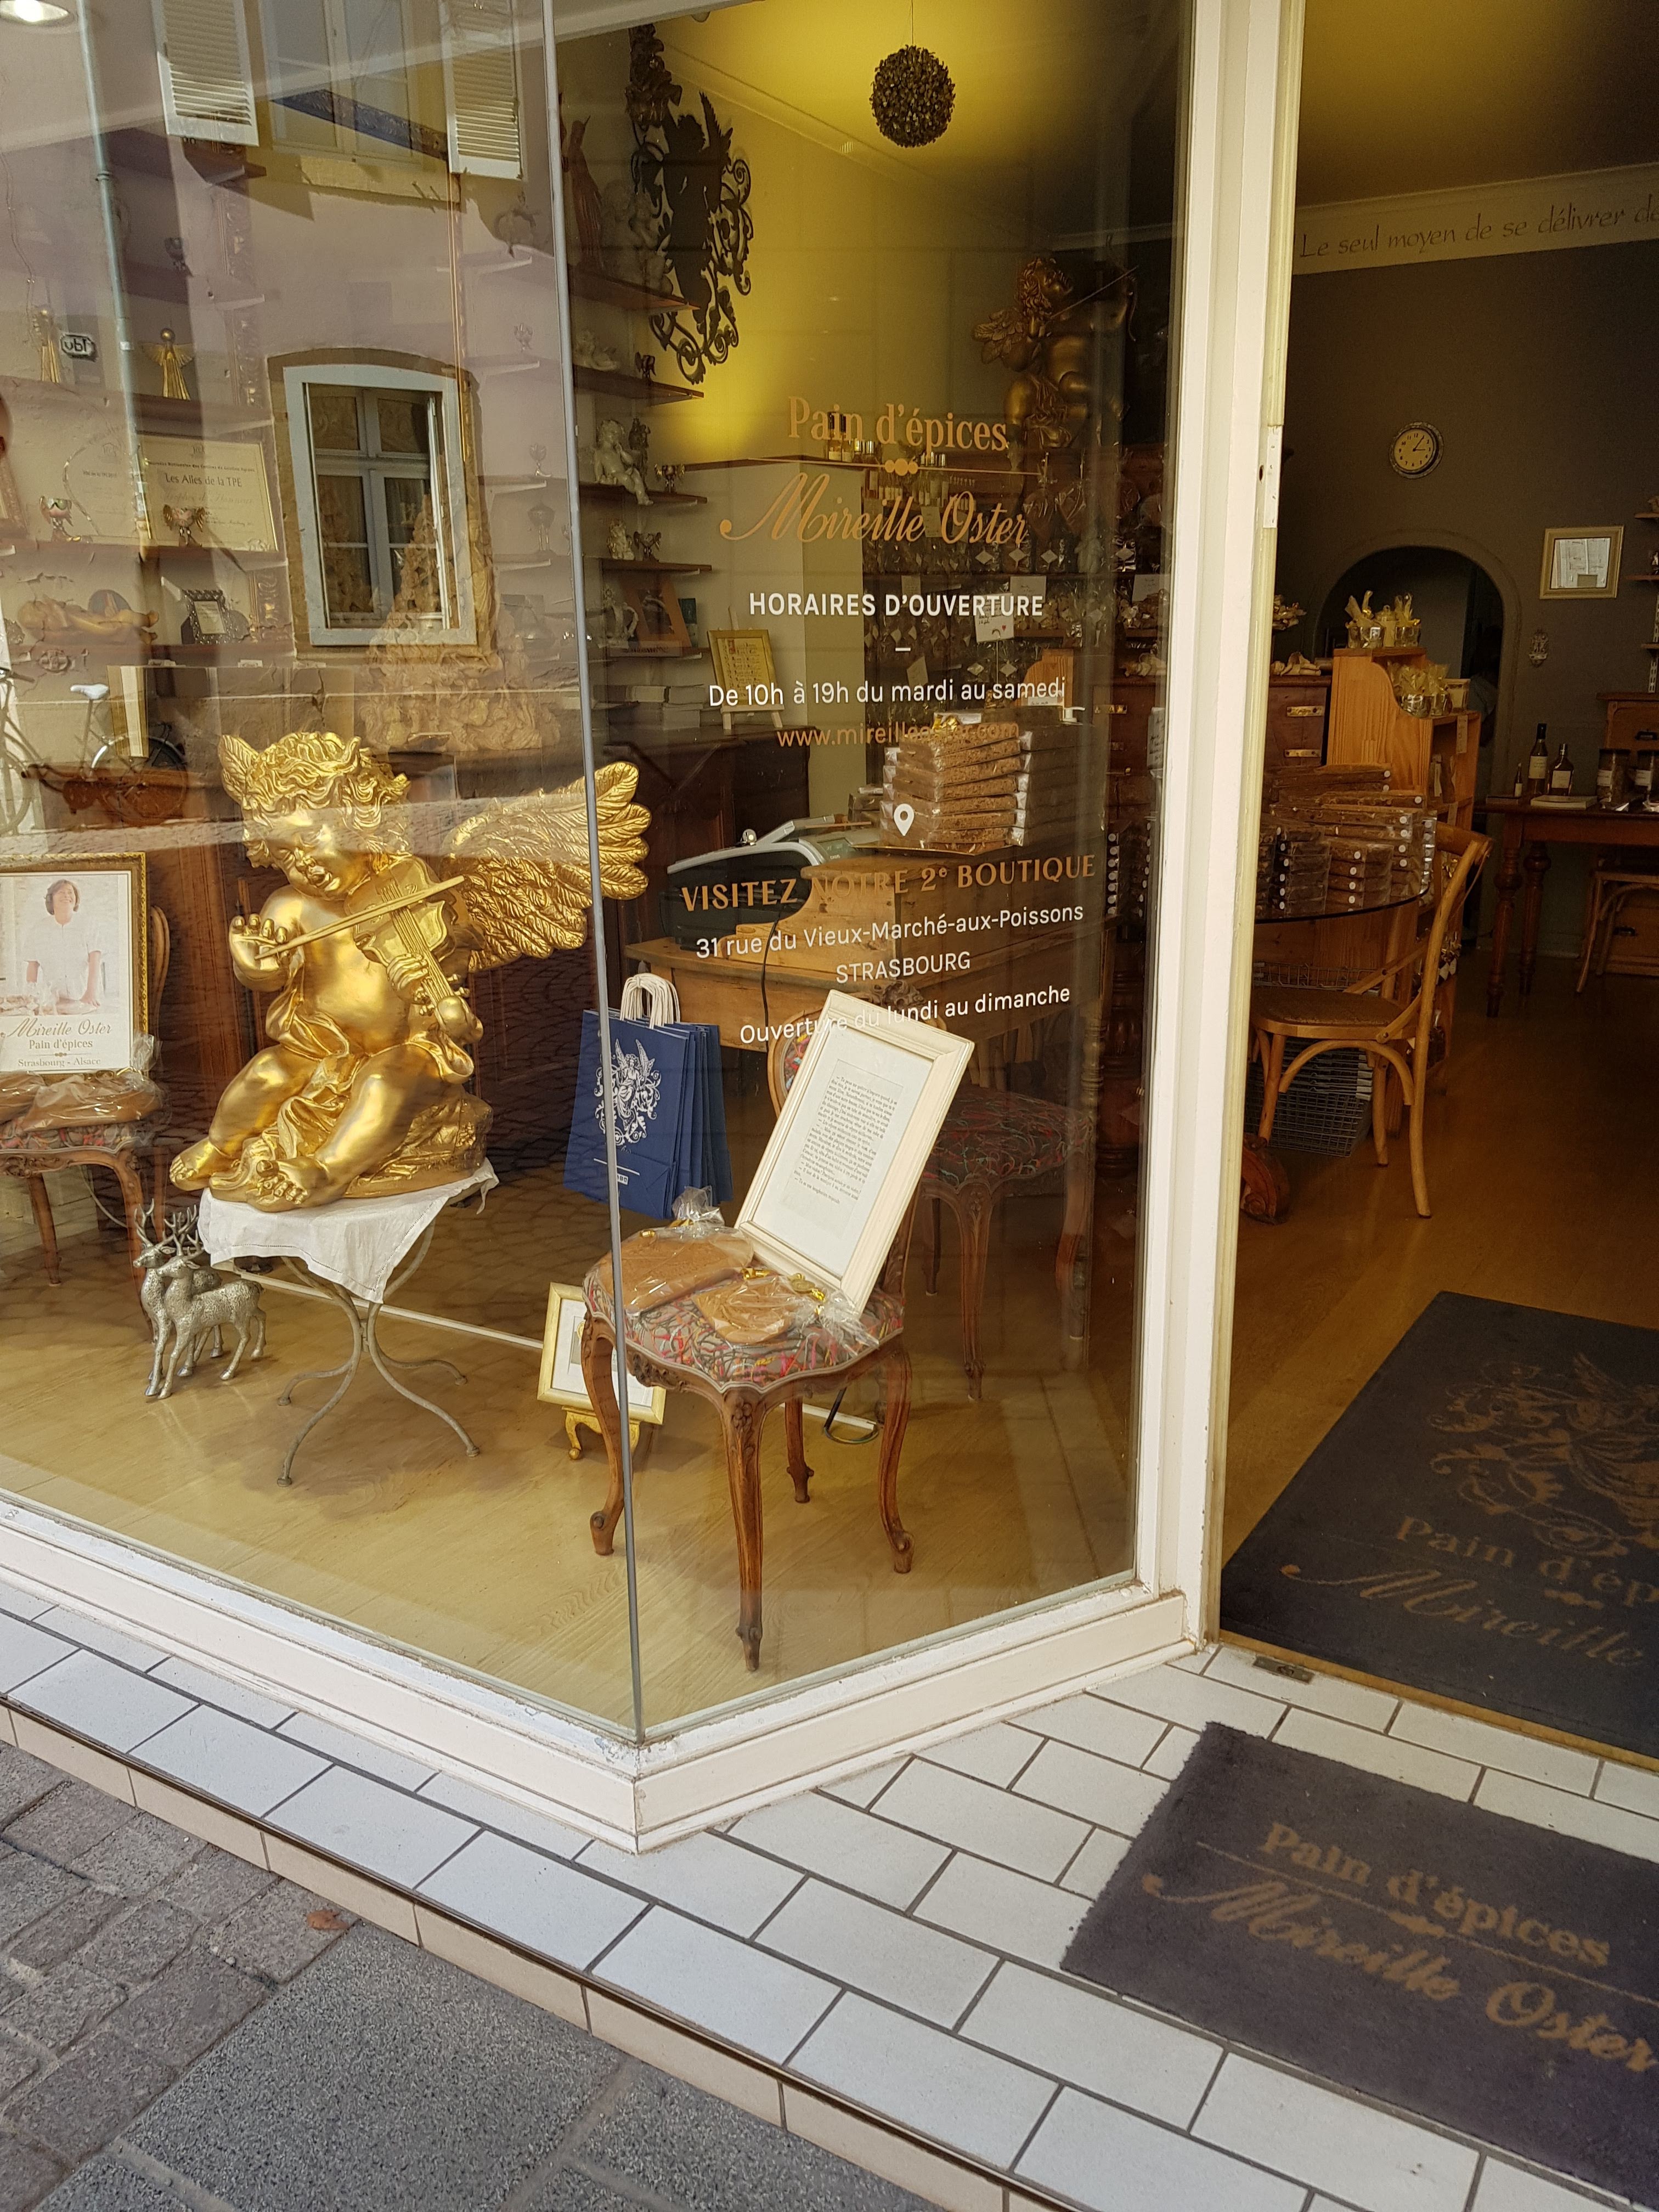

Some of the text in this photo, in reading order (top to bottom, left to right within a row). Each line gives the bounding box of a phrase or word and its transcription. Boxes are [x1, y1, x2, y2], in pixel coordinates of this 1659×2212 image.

[1300, 233, 1330, 258] Le
[1339, 224, 1379, 255] seul
[1388, 228, 1456, 255] moyen
[1466, 213, 1493, 240] de
[1502, 219, 1527, 239] se
[1538, 202, 1627, 234] délivrer
[788, 396, 1007, 454] Pain d'épices
[165, 473, 179, 483] Les
[205, 475, 215, 486] de
[218, 476, 224, 487] la
[227, 477, 242, 488] TPE
[719, 472, 1028, 544] Mireille Oster
[749, 592, 876, 617] HORAIRES
[885, 594, 1043, 617] D'OUVERTURE
[709, 676, 1065, 707] De 10h à 19h du mardi au samedi
[681, 879, 798, 912] VISITEZ
[811, 870, 909, 901] NOTRE
[958, 855, 1096, 888] BOUTIQUE
[696, 905, 1084, 959] 31 rue du Vieux-Marché-aux-Poissons
[836, 951, 970, 984] STRASBOURG
[0, 1017, 112, 1038] Mireille Oster
[741, 986, 1070, 1044] Ouverture du lundi au dimanche
[18, 1058, 65, 1067] Strasbourg
[74, 1057, 101, 1065] Alsace
[29, 1039, 93, 1051] Pain d'épices
[1397, 1516, 1516, 1568] Pain
[1279, 1563, 1644, 1667] Mireille
[1257, 1822, 1610, 1967] Pain d'épices
[1142, 1873, 1659, 2072] Mireille Oster
